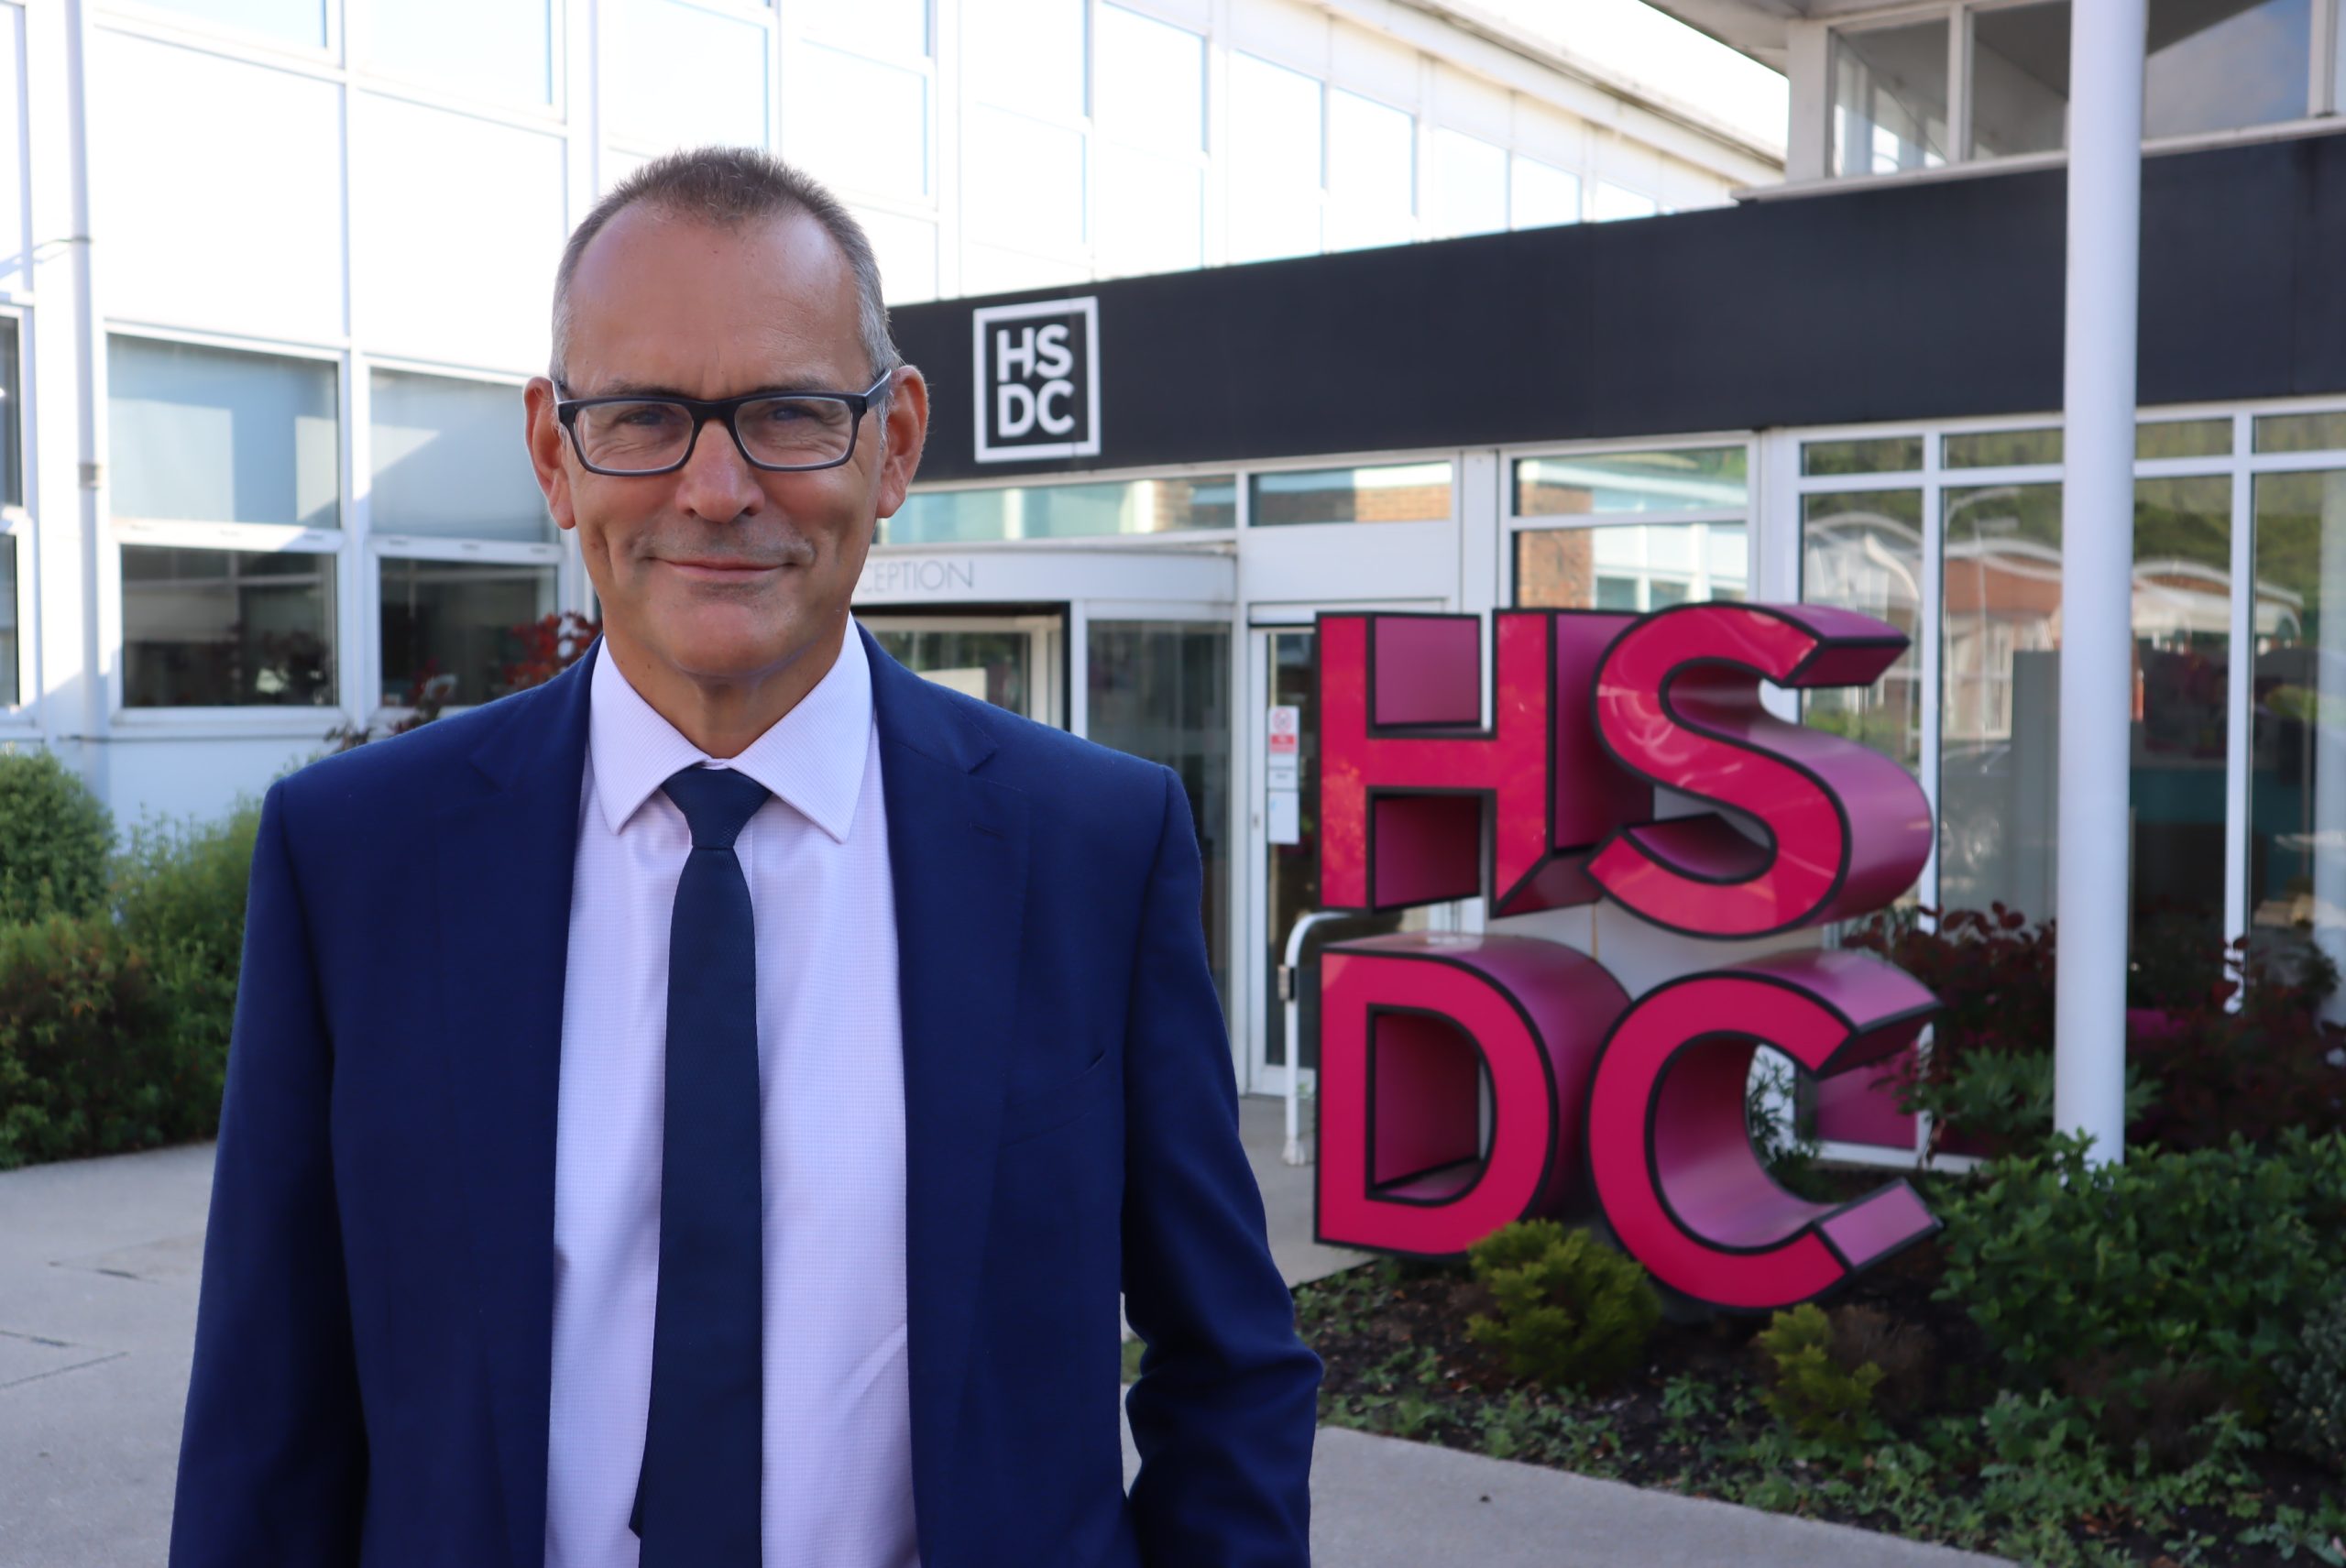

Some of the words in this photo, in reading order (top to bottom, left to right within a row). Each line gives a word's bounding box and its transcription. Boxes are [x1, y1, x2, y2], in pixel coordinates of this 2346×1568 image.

[996, 323, 1073, 382] HS
[997, 378, 1075, 438] DC
[1315, 601, 1852, 940] HS
[1314, 943, 1858, 1314] DC
